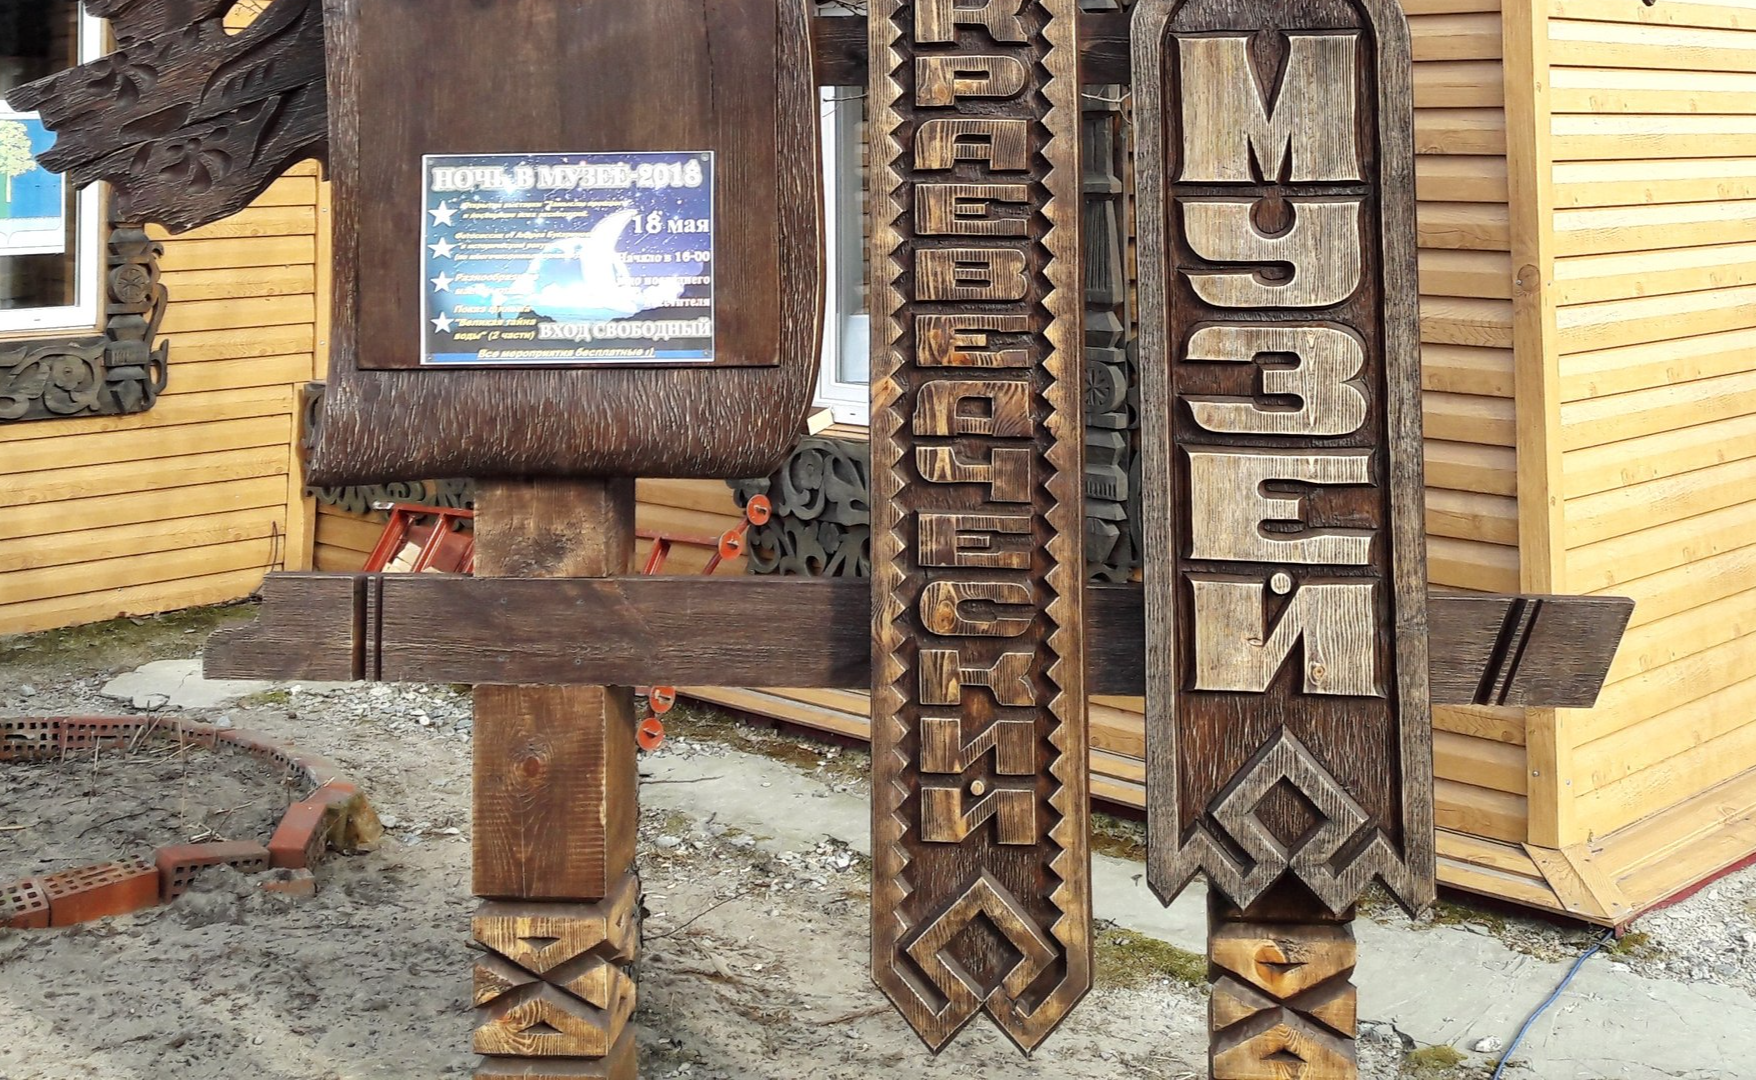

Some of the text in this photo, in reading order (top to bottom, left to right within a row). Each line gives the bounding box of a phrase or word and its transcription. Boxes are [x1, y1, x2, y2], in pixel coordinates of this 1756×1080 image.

[432, 160, 703, 191] НОЧЬ В МУЗЕЕ-2018
[632, 212, 709, 233] 18 мая
[674, 250, 710, 263] 16-00
[501, 330, 536, 341] части)
[537, 316, 712, 342] ВХОД СВОБОДНЫЙ
[477, 348, 500, 359] Все
[500, 348, 574, 359] мероприятия
[573, 347, 644, 358] бесплатные
[1179, 34, 1378, 696] МУЗЕЙ
